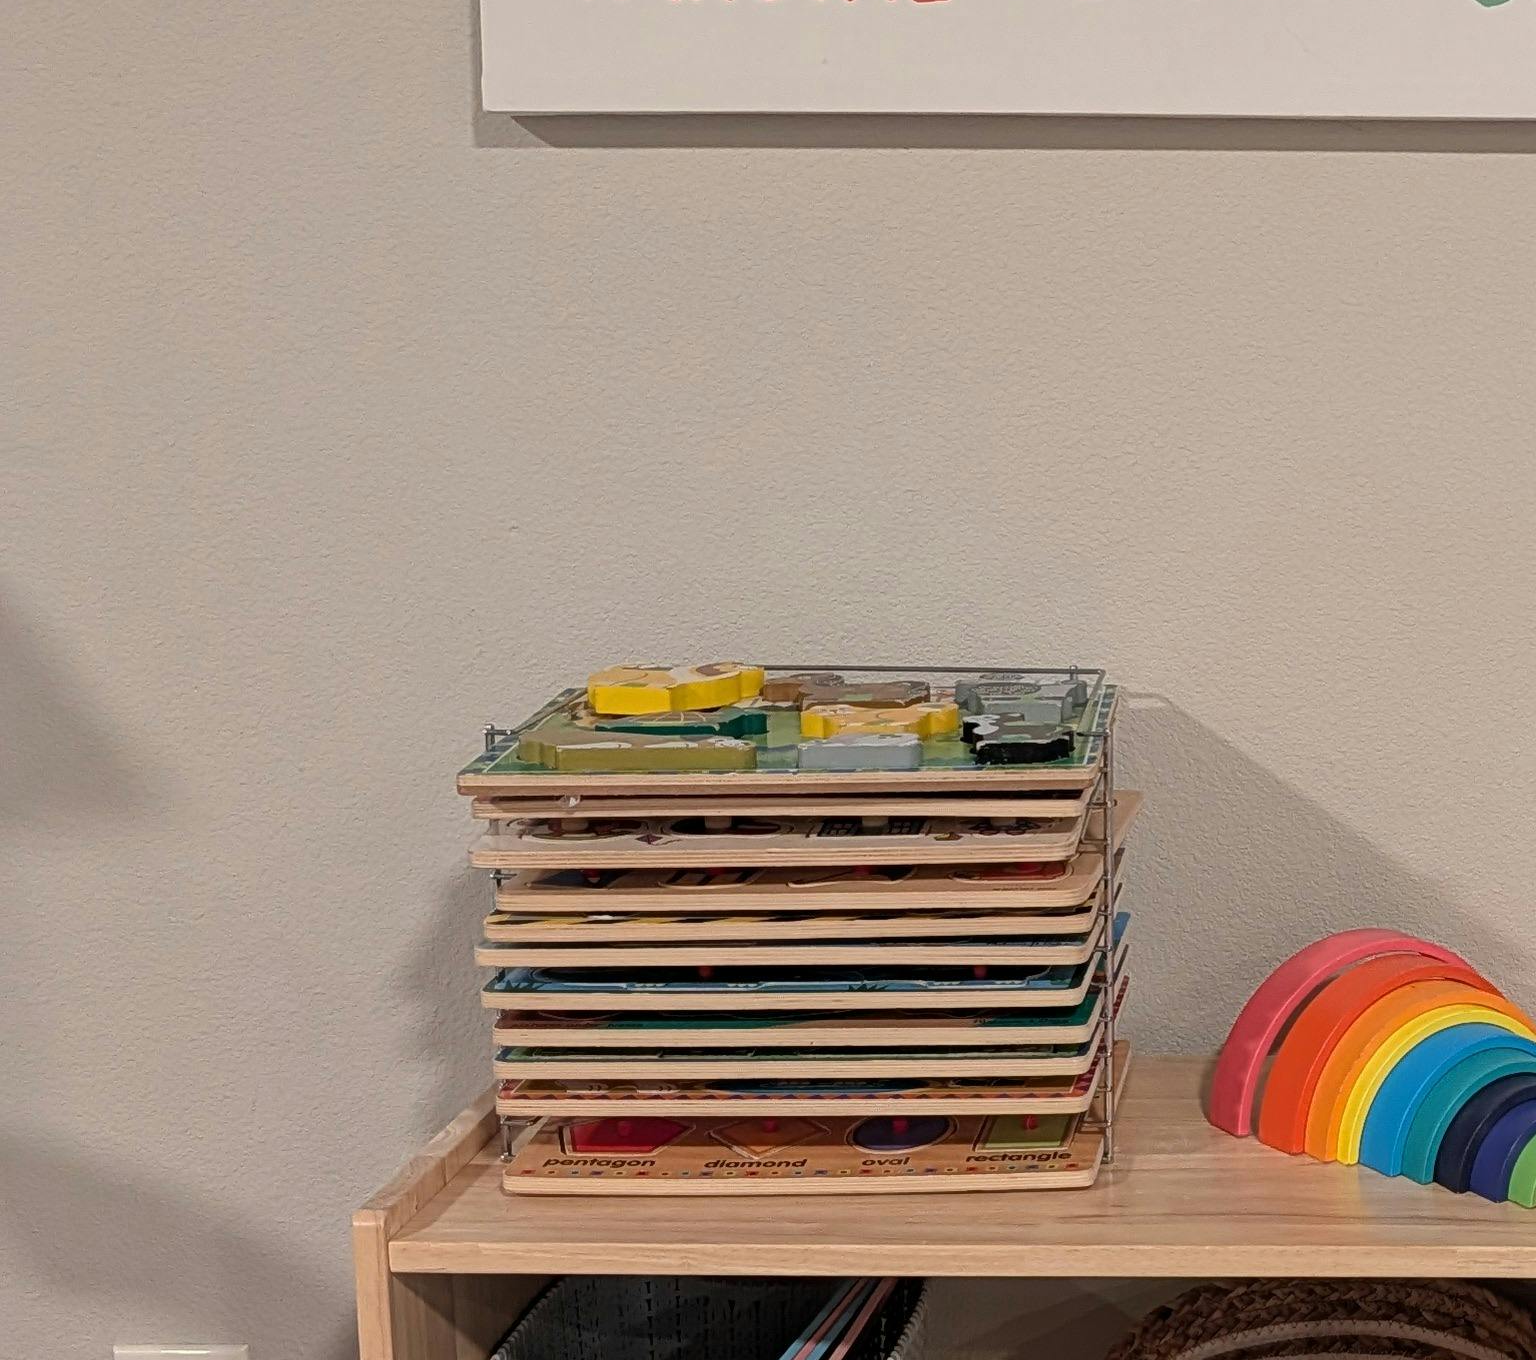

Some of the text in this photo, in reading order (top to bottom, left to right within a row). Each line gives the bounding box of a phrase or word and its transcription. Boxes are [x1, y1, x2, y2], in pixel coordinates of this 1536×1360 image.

[542, 1151, 1073, 1168] pentagon diamond oval rectangle
